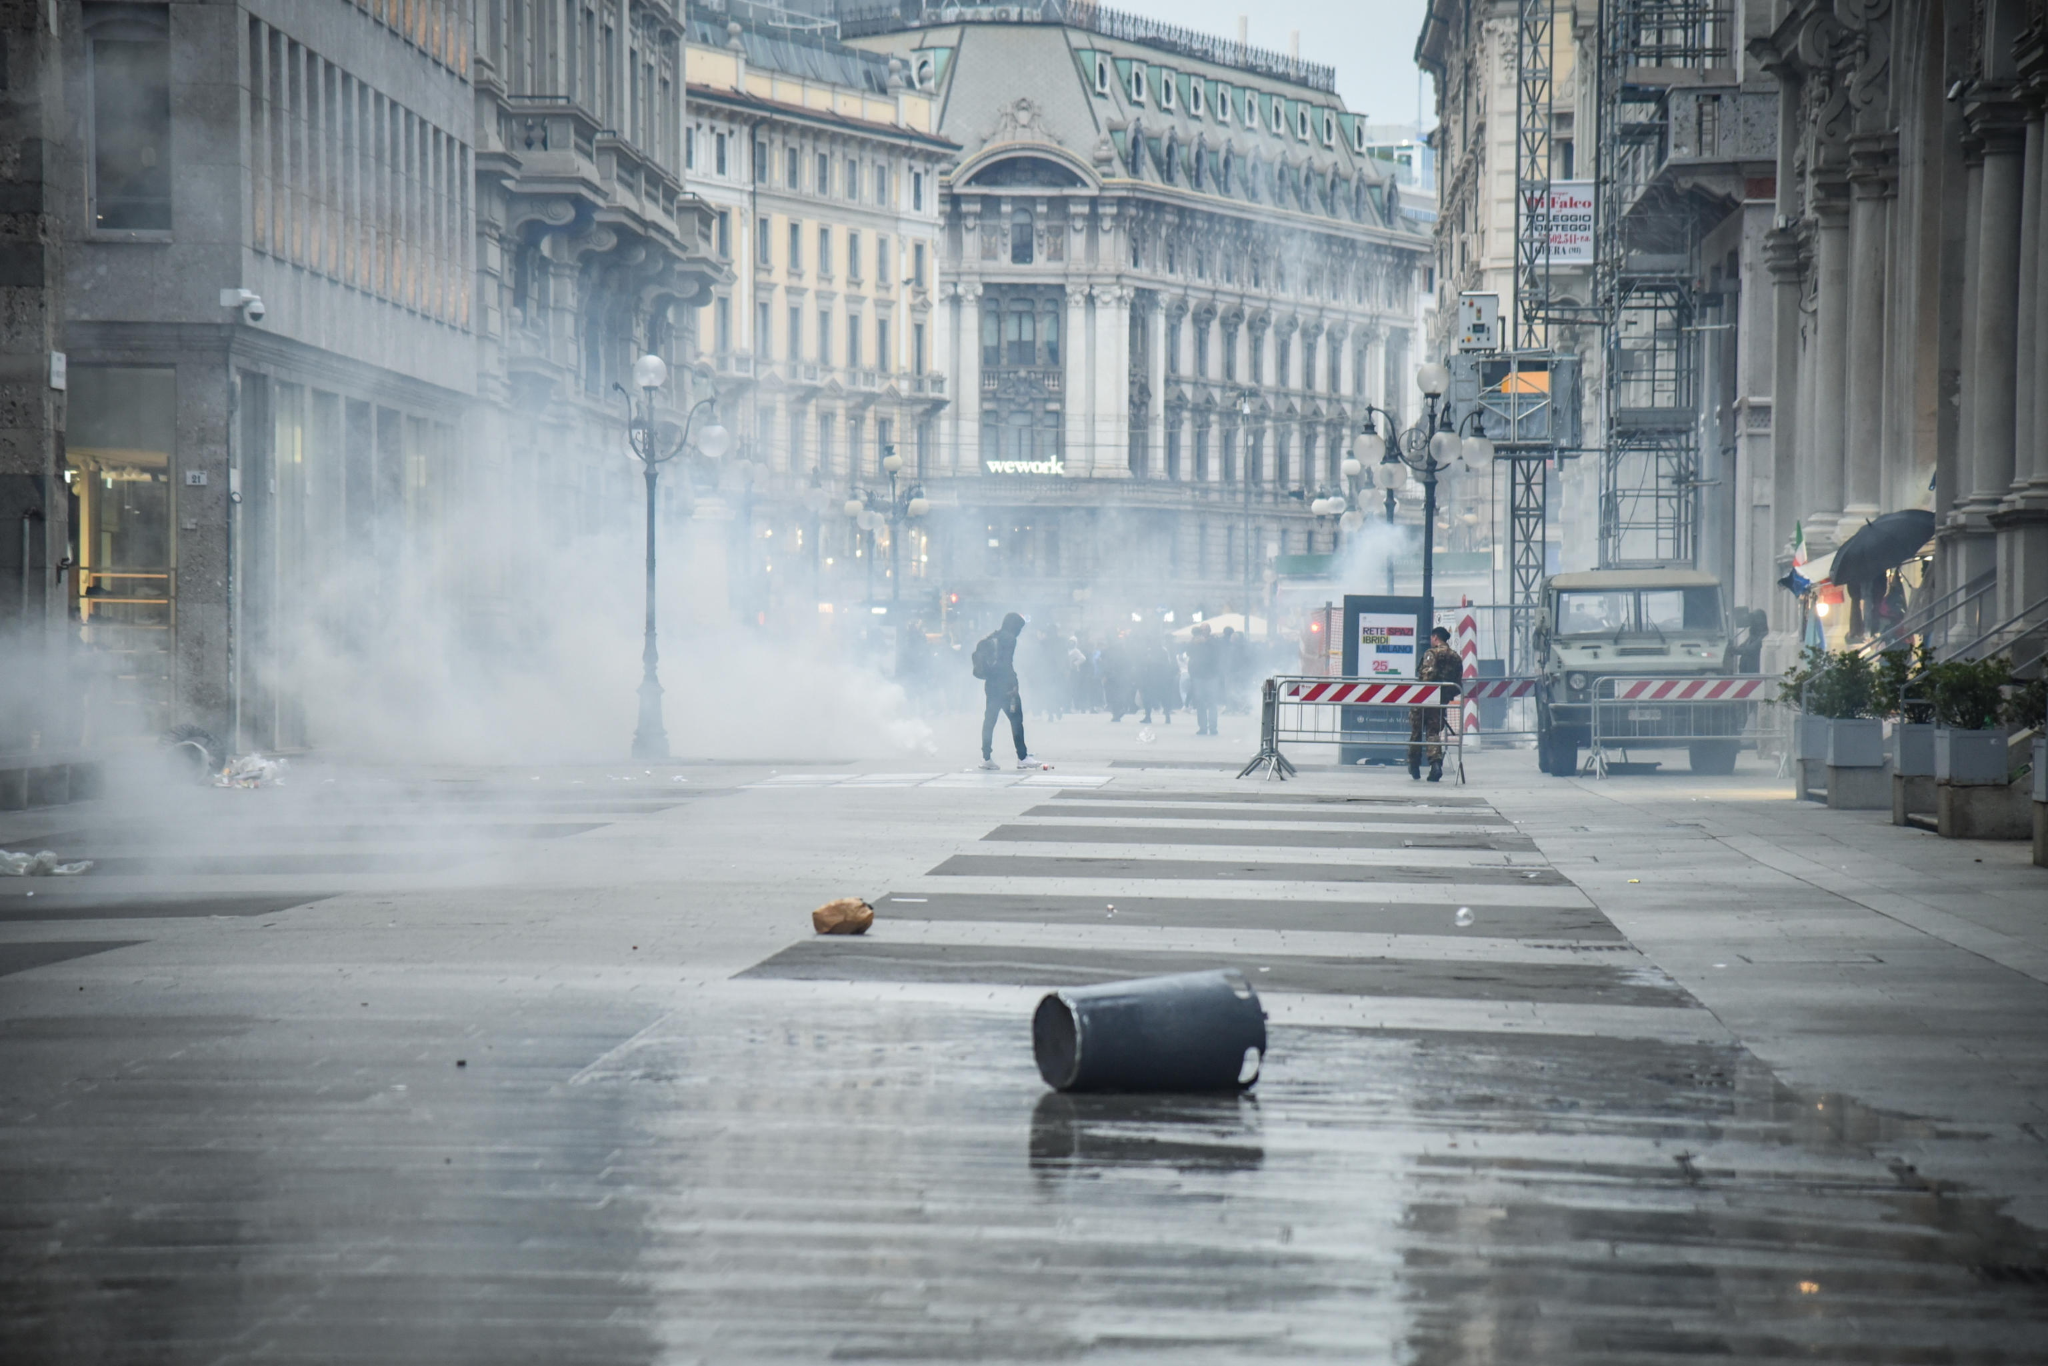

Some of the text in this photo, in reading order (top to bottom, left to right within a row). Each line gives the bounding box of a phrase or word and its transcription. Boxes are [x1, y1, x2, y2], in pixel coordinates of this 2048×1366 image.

[1551, 196, 1592, 209] Falco
[1526, 214, 1592, 222] OEGGIO
[1526, 224, 1591, 232] ONTEGGI
[986, 455, 1064, 474] wework
[191, 474, 201, 484] 21
[1362, 627, 1414, 636] RETE SPAZI
[1362, 635, 1389, 644] IBRIDI
[1376, 645, 1413, 654] MILANO
[1372, 660, 1388, 671] 25
